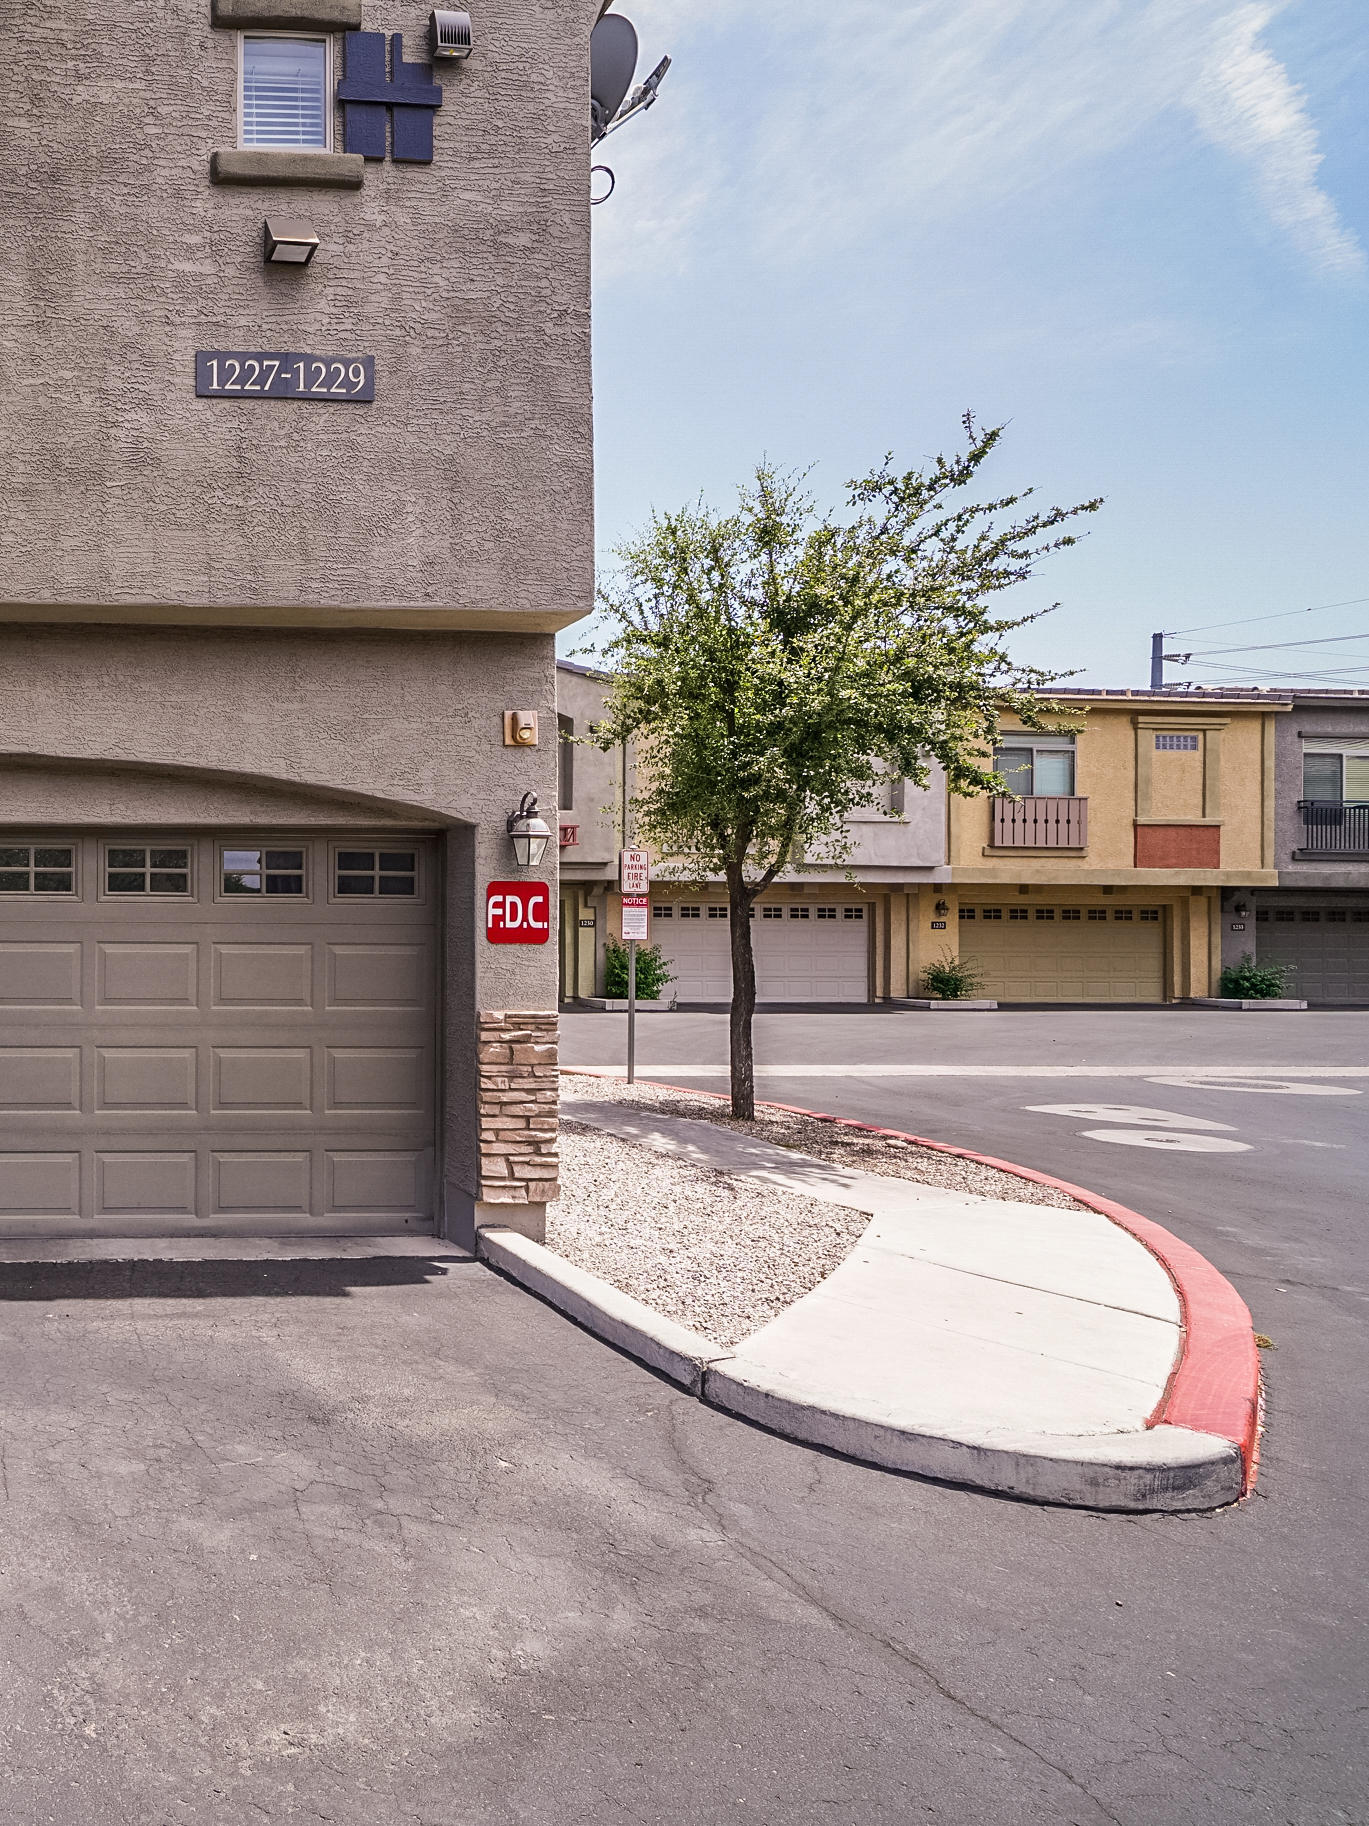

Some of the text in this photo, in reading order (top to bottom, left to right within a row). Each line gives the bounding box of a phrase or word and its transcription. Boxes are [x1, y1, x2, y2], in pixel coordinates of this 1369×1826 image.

[206, 358, 366, 394] 1227-1229
[629, 853, 641, 863] NO
[624, 863, 647, 871] PARKING
[627, 872, 644, 881] FIRE
[628, 882, 642, 890] LANE
[622, 897, 648, 905] NOTICE
[487, 894, 548, 929] F.D.C.
